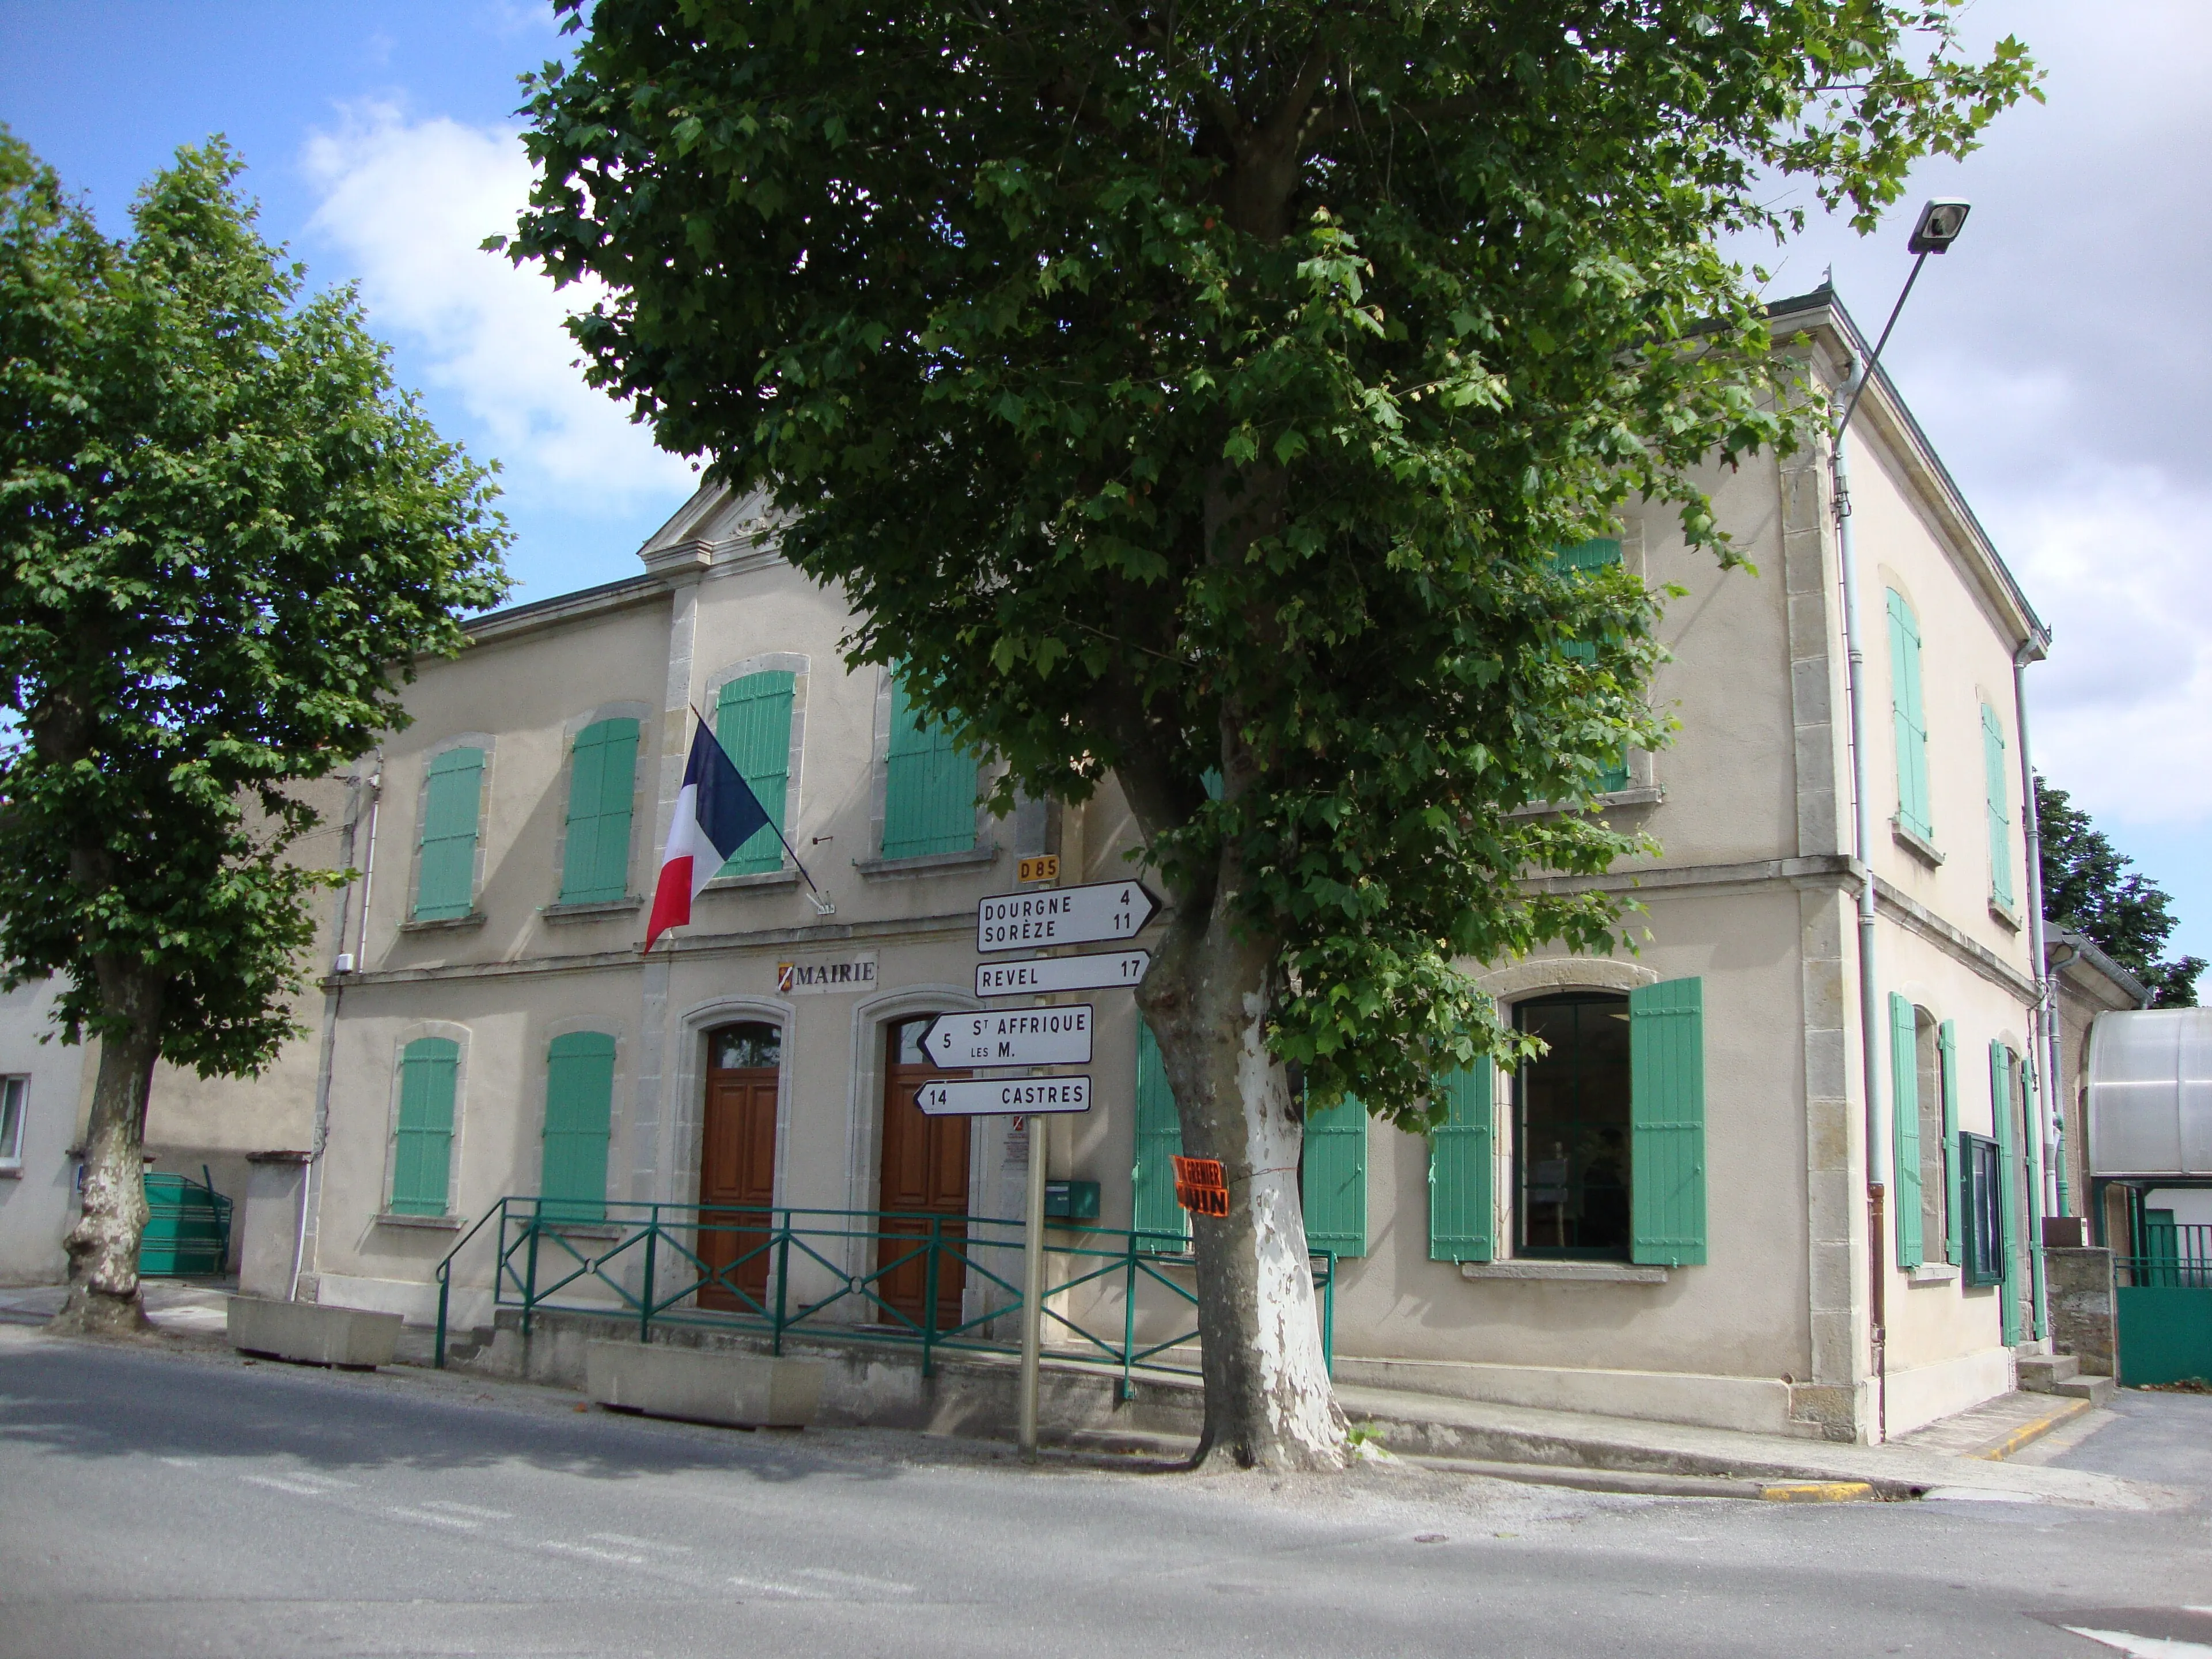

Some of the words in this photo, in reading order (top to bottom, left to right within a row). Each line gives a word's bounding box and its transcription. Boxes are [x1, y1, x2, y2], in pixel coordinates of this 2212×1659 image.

[1021, 863, 1029, 878] D
[1036, 859, 1056, 876] 85
[985, 896, 1071, 921] DOURGNE
[1120, 889, 1130, 905] 4
[984, 919, 1055, 942] SORÈZE
[1114, 912, 1130, 930] 11
[796, 962, 874, 985] MAIRIE
[983, 968, 1037, 987] REVEL
[1122, 960, 1140, 977] 17
[998, 1014, 1085, 1035] AFFRIQUE
[943, 1033, 951, 1048] 5
[971, 1048, 988, 1058] LES
[998, 1041, 1015, 1058] M.
[930, 1089, 946, 1105] 14
[1002, 1086, 1083, 1104] CASTRES
